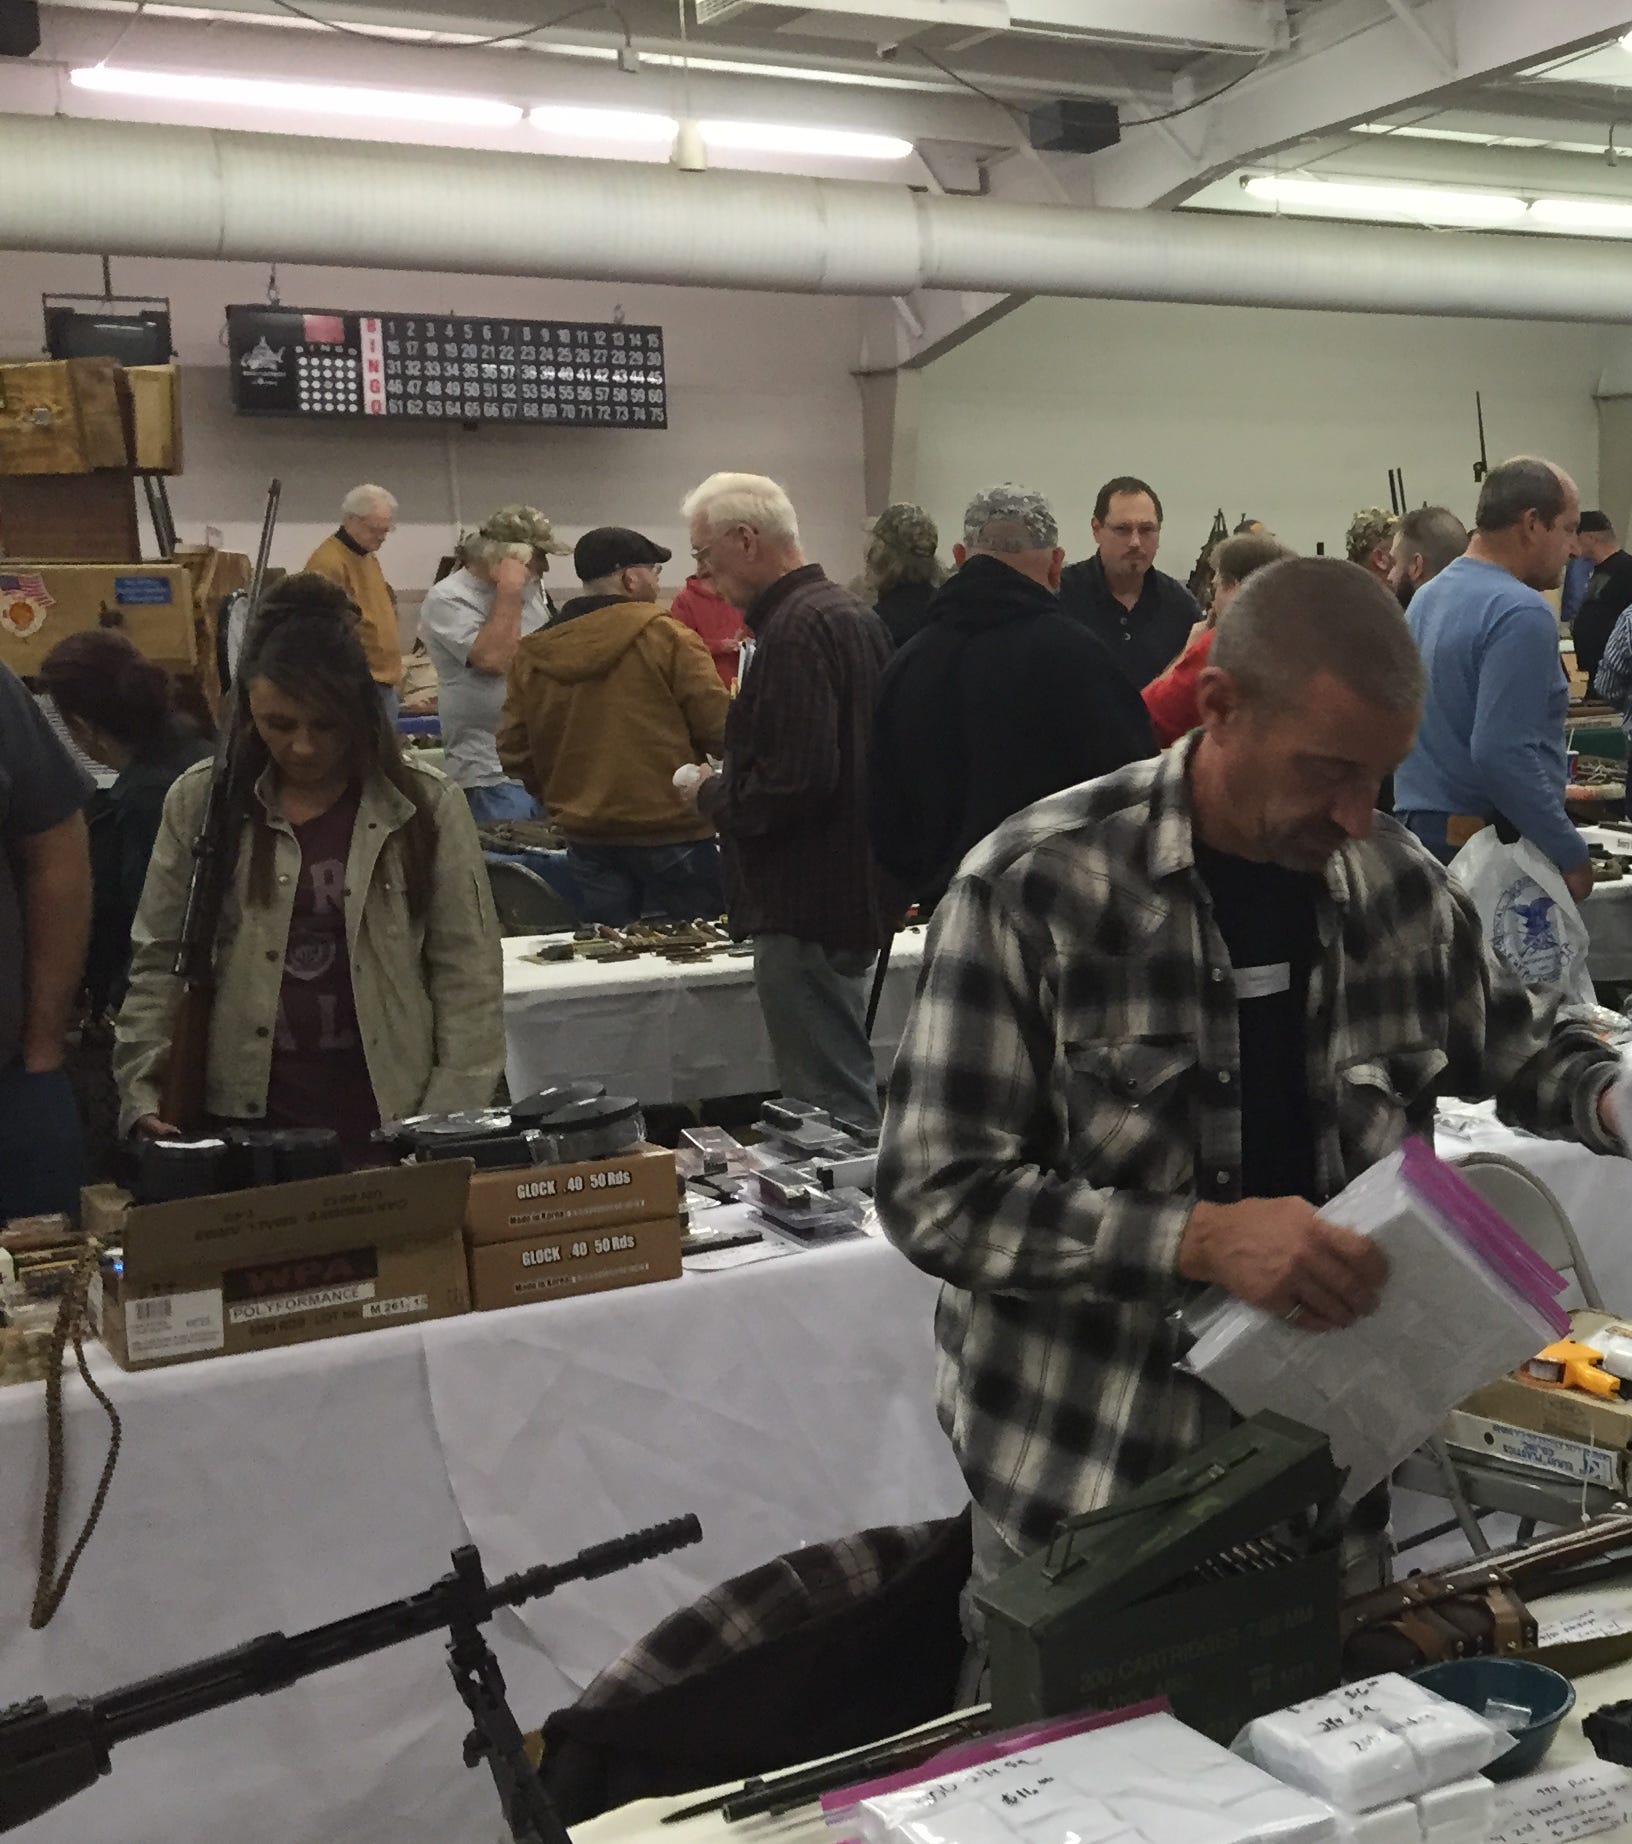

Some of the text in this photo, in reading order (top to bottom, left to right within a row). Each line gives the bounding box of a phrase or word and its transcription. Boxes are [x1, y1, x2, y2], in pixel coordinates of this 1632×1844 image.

[389, 322, 394, 335] 1
[407, 322, 415, 337] 2
[426, 323, 434, 337] 3
[445, 324, 454, 337] 4
[464, 324, 472, 339] 5
[483, 325, 491, 341] 6
[501, 326, 509, 340] 7
[540, 328, 549, 342] 9
[577, 330, 588, 344] 11
[594, 331, 606, 345] 12
[629, 333, 641, 346] 14
[406, 341, 418, 355] 17
[444, 343, 458, 357] 19
[461, 344, 477, 358] 20
[481, 345, 495, 359] 21
[499, 346, 514, 360] 22
[521, 346, 536, 360] 23
[539, 347, 553, 361] 24
[557, 347, 572, 362] 25
[575, 348, 591, 363] 26
[593, 349, 607, 364] 27
[611, 350, 626, 364] 28
[629, 351, 643, 365] 29
[387, 360, 401, 374] 31
[405, 360, 421, 376] 32
[424, 361, 441, 376] 33
[444, 362, 460, 376] 34
[463, 363, 478, 378] 35
[500, 364, 515, 379] 37
[521, 365, 537, 379] 38
[540, 366, 555, 380] 39
[576, 368, 591, 381] 41
[594, 368, 609, 383] 42
[612, 369, 628, 383] 43
[630, 370, 645, 383] 44
[647, 371, 662, 385] 45
[407, 380, 422, 395] 47
[445, 381, 460, 396] 49
[464, 382, 480, 397] 50
[483, 383, 497, 397] 51
[501, 383, 516, 398] 52
[523, 384, 538, 398] 53
[541, 385, 556, 399] 54
[559, 386, 574, 400] 55
[577, 386, 592, 400] 56
[595, 387, 609, 400] 57
[613, 388, 628, 402] 58
[631, 388, 645, 403] 59
[407, 400, 423, 414] 62
[426, 400, 442, 415] 63
[446, 401, 461, 415] 64
[464, 402, 480, 417] 65
[483, 402, 499, 417] 66
[502, 403, 517, 417] 67
[524, 403, 539, 417] 68
[560, 404, 575, 419] 70
[579, 405, 593, 418] 71
[596, 406, 610, 420] 72
[614, 406, 628, 421] 73
[633, 407, 646, 421] 74
[650, 408, 664, 422] 75
[516, 1179, 556, 1200] GLOCK
[563, 1176, 583, 1193] .40
[522, 1246, 561, 1267] GLOCK
[569, 1242, 588, 1259] .40
[233, 1287, 359, 1319] POLYFORMANCE
